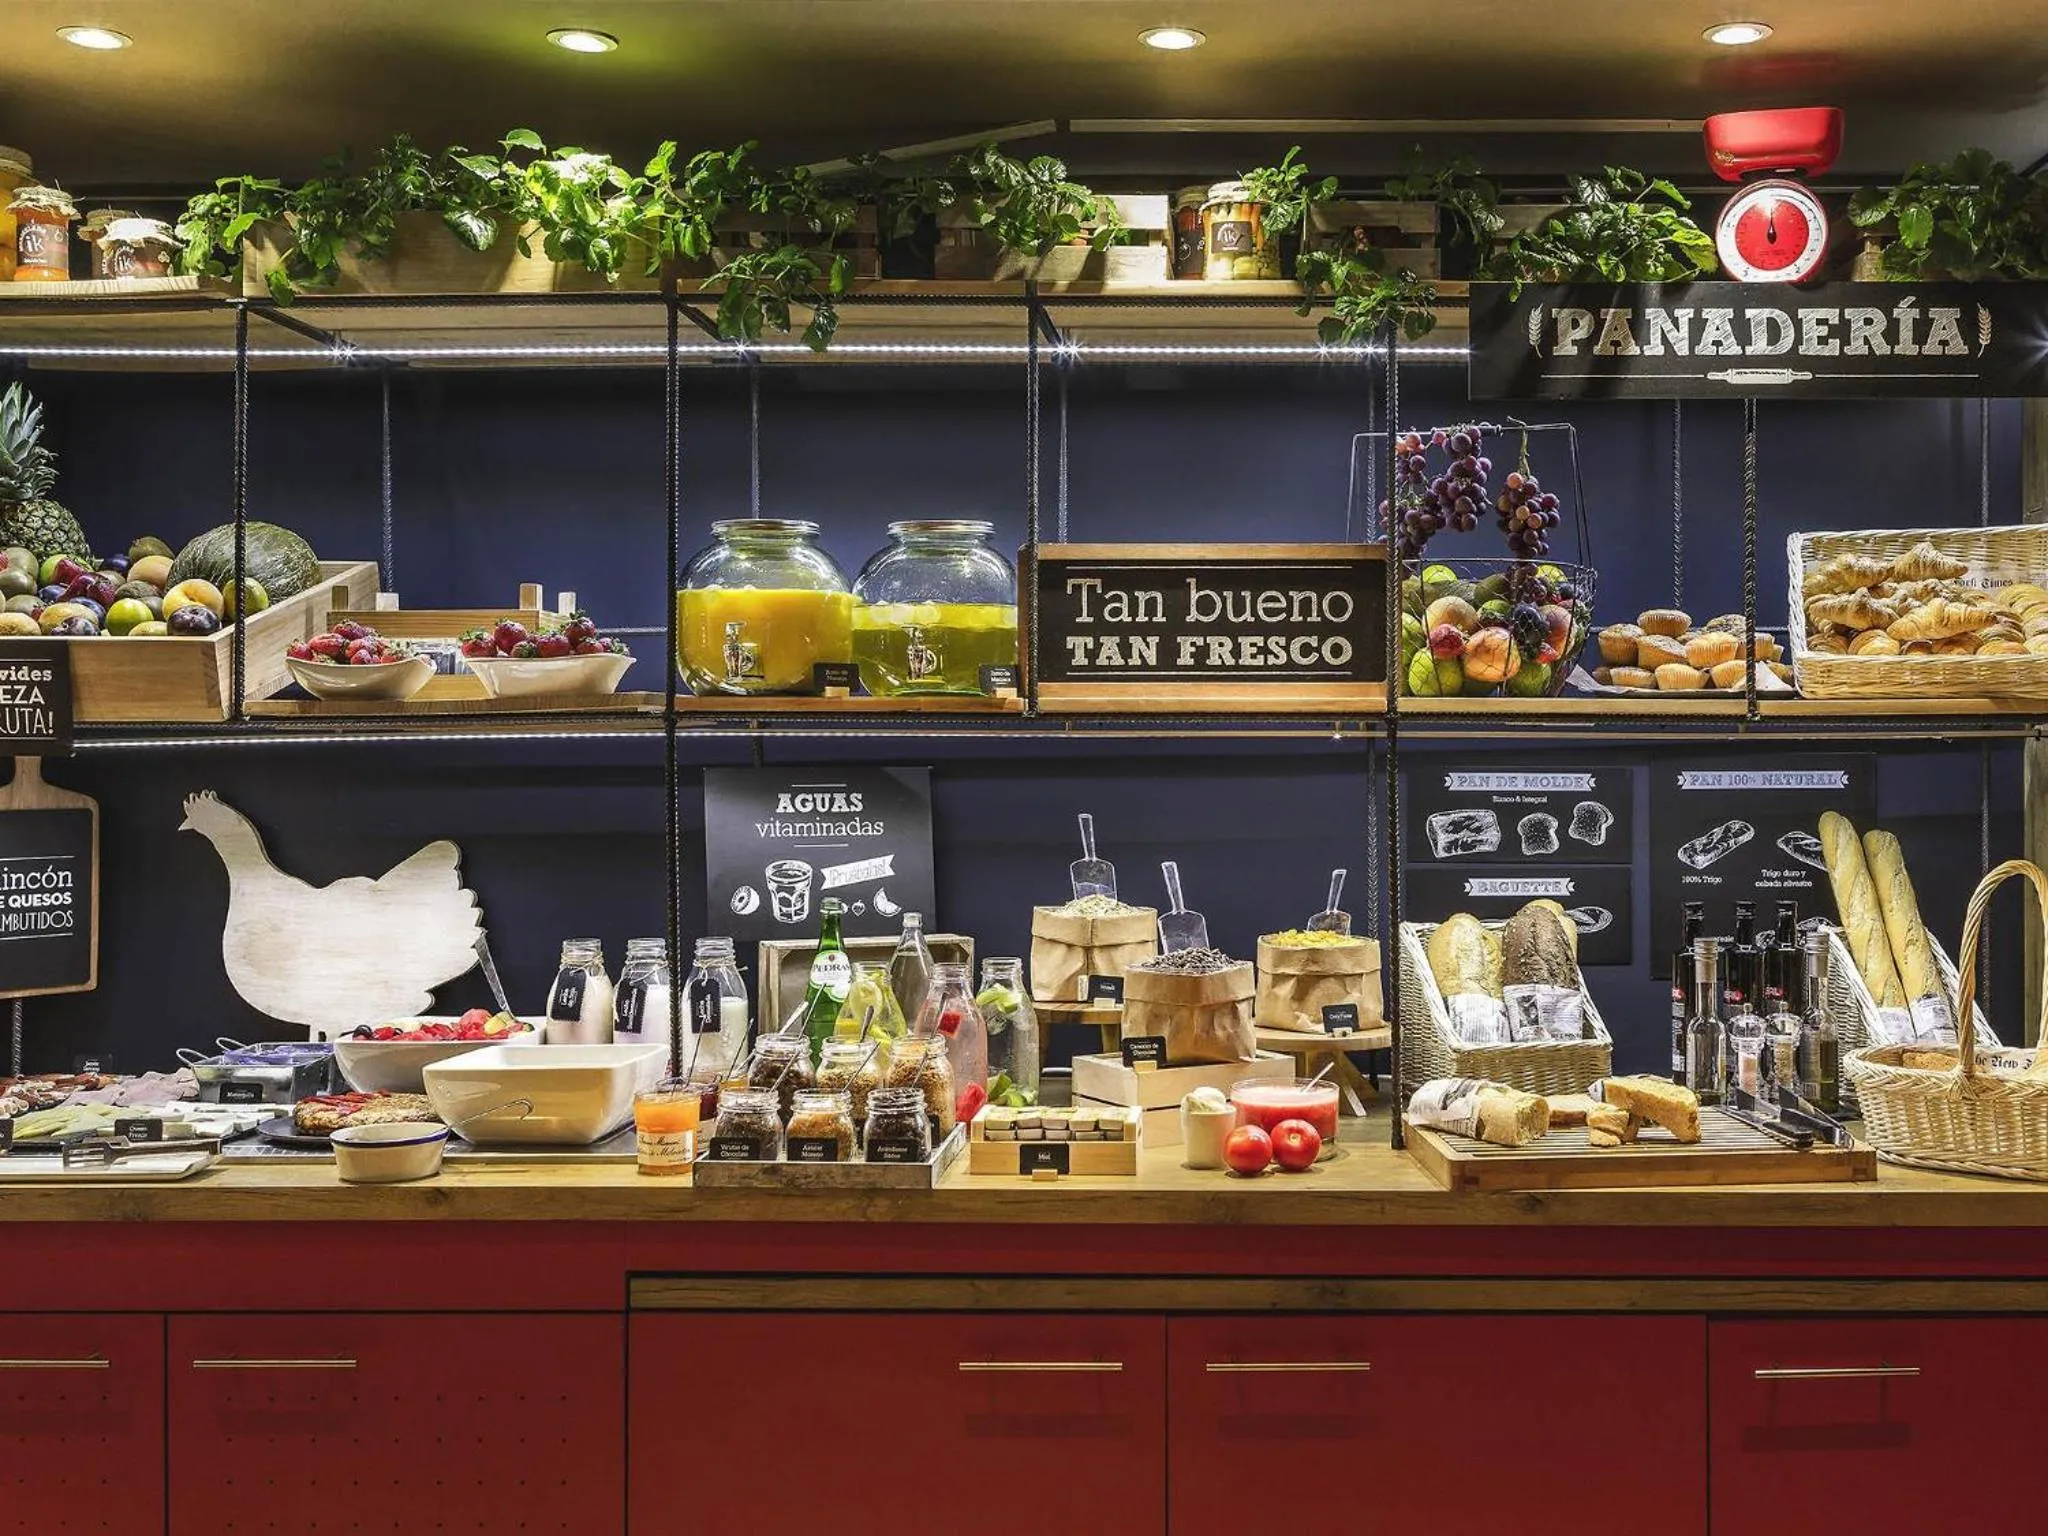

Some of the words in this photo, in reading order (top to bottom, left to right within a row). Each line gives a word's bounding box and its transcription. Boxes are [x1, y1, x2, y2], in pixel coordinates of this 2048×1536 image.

[1551, 295, 1970, 356] PANADERÍA
[1066, 578, 1166, 623] Tan
[1186, 578, 1354, 623] bueno
[1066, 636, 1160, 666] TAN
[1176, 636, 1353, 666] FRESCO
[0, 707, 54, 734] UTA!
[1457, 775, 1490, 787] PAN
[1496, 776, 1519, 788] DE
[1524, 776, 1584, 788] MOLDE
[1690, 774, 1722, 786] PAN
[1761, 774, 1838, 786] NATURAL
[776, 793, 863, 813] AGUAS
[755, 818, 884, 838] vitaminadas
[0, 864, 73, 891] incón
[1761, 869, 1782, 878] Trigo
[1782, 869, 1800, 877] duro
[1478, 881, 1562, 894] BAGUETTE
[8, 891, 72, 908] QUESOS
[0, 910, 73, 932] MBUTIDOS
